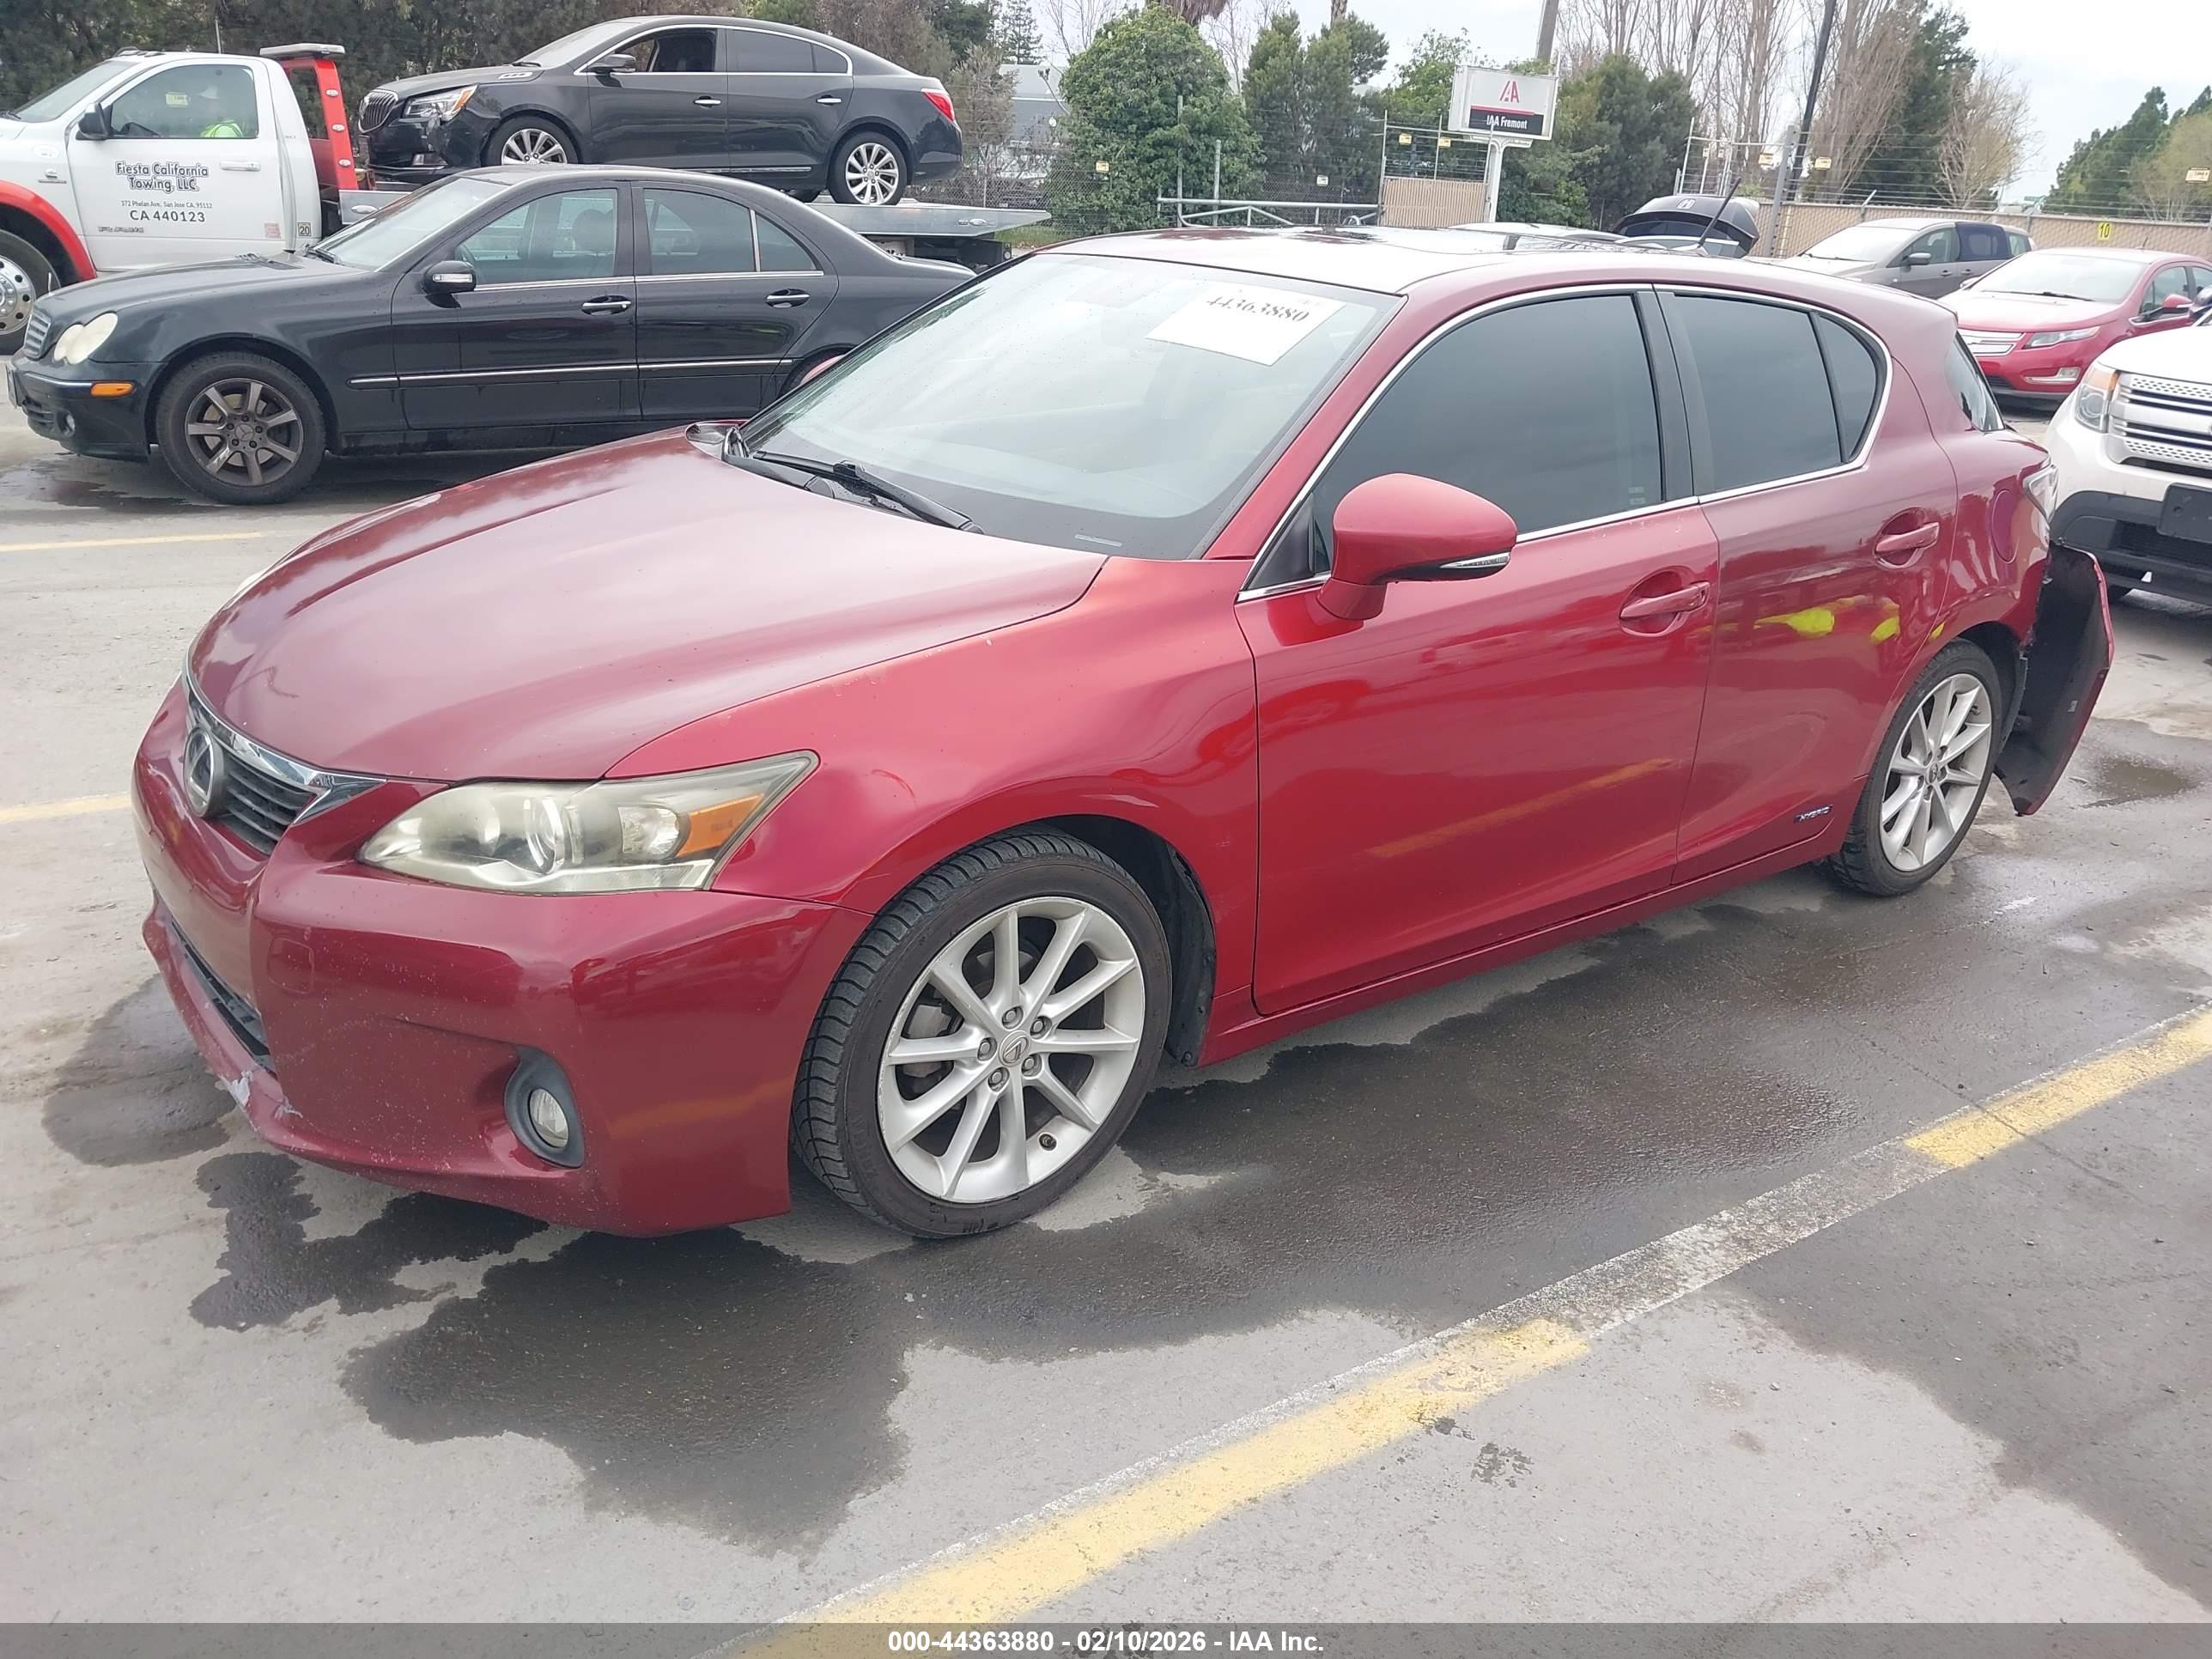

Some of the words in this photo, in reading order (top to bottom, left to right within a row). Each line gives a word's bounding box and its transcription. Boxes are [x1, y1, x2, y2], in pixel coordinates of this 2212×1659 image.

[1500, 116, 1528, 130] Fremont
[115, 161, 150, 175] Fiesta
[153, 161, 208, 177] California
[130, 210, 150, 221] CA
[153, 210, 205, 222] 440123
[299, 226, 310, 235] 20
[2100, 223, 2110, 238] 10
[1206, 295, 1310, 322] 44363880
